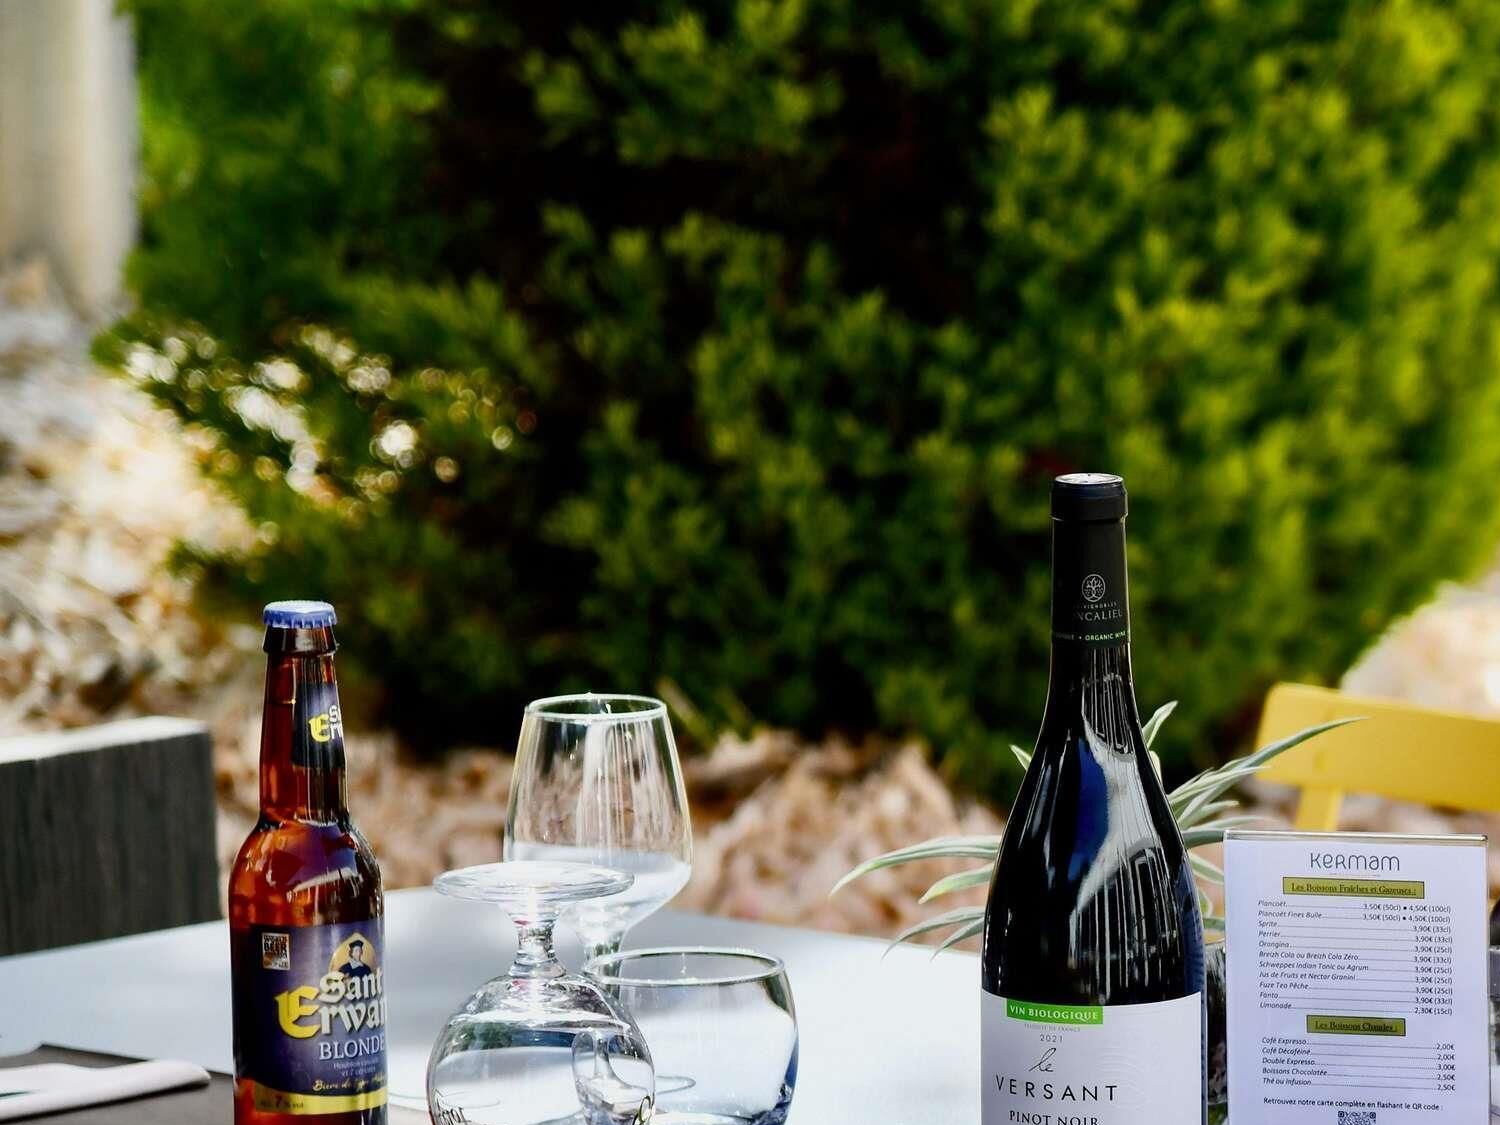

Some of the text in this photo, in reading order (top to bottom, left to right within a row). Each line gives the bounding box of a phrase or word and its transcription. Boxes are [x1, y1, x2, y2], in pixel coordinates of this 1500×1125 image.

[1084, 633, 1114, 641] ORGANIC
[1291, 882, 1306, 892] Les
[1258, 920, 1278, 928] Sprite
[1259, 961, 1294, 969] Schweppes
[1010, 1004, 1098, 1022] VIN BIOLOGIQUE
[1315, 1020, 1327, 1030] Les
[1040, 1034, 1063, 1043] 2021
[1262, 1036, 1276, 1045] Café
[1278, 1038, 1307, 1046] Expresso
[1262, 1047, 1276, 1055] Café
[1028, 1047, 1056, 1072] le
[1286, 1058, 1315, 1067] Expresso
[1263, 1068, 1290, 1076] Boissons
[995, 1074, 1118, 1101] VERSANT
[1335, 1100, 1366, 1109] complète
[1009, 1110, 1052, 1125] PINOT
